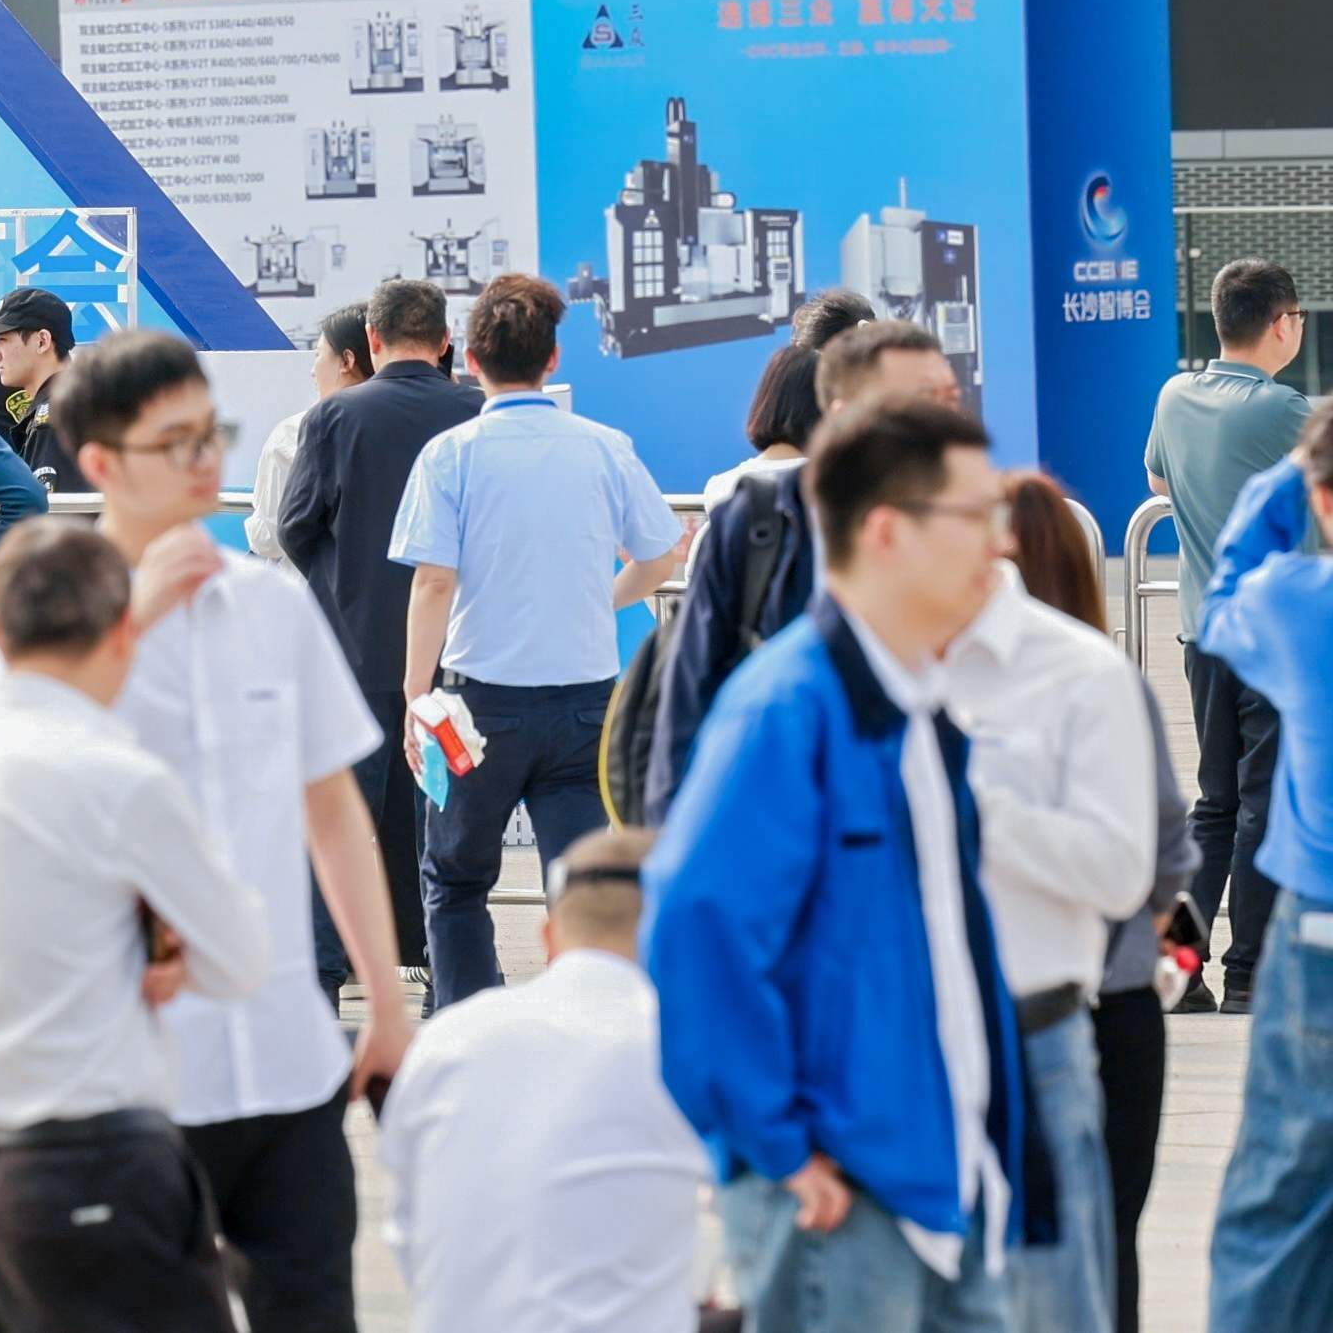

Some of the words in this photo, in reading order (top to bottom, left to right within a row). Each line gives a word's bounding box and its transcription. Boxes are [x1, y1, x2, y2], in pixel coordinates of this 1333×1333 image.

[1062, 289, 1151, 322] 长沙智博会
